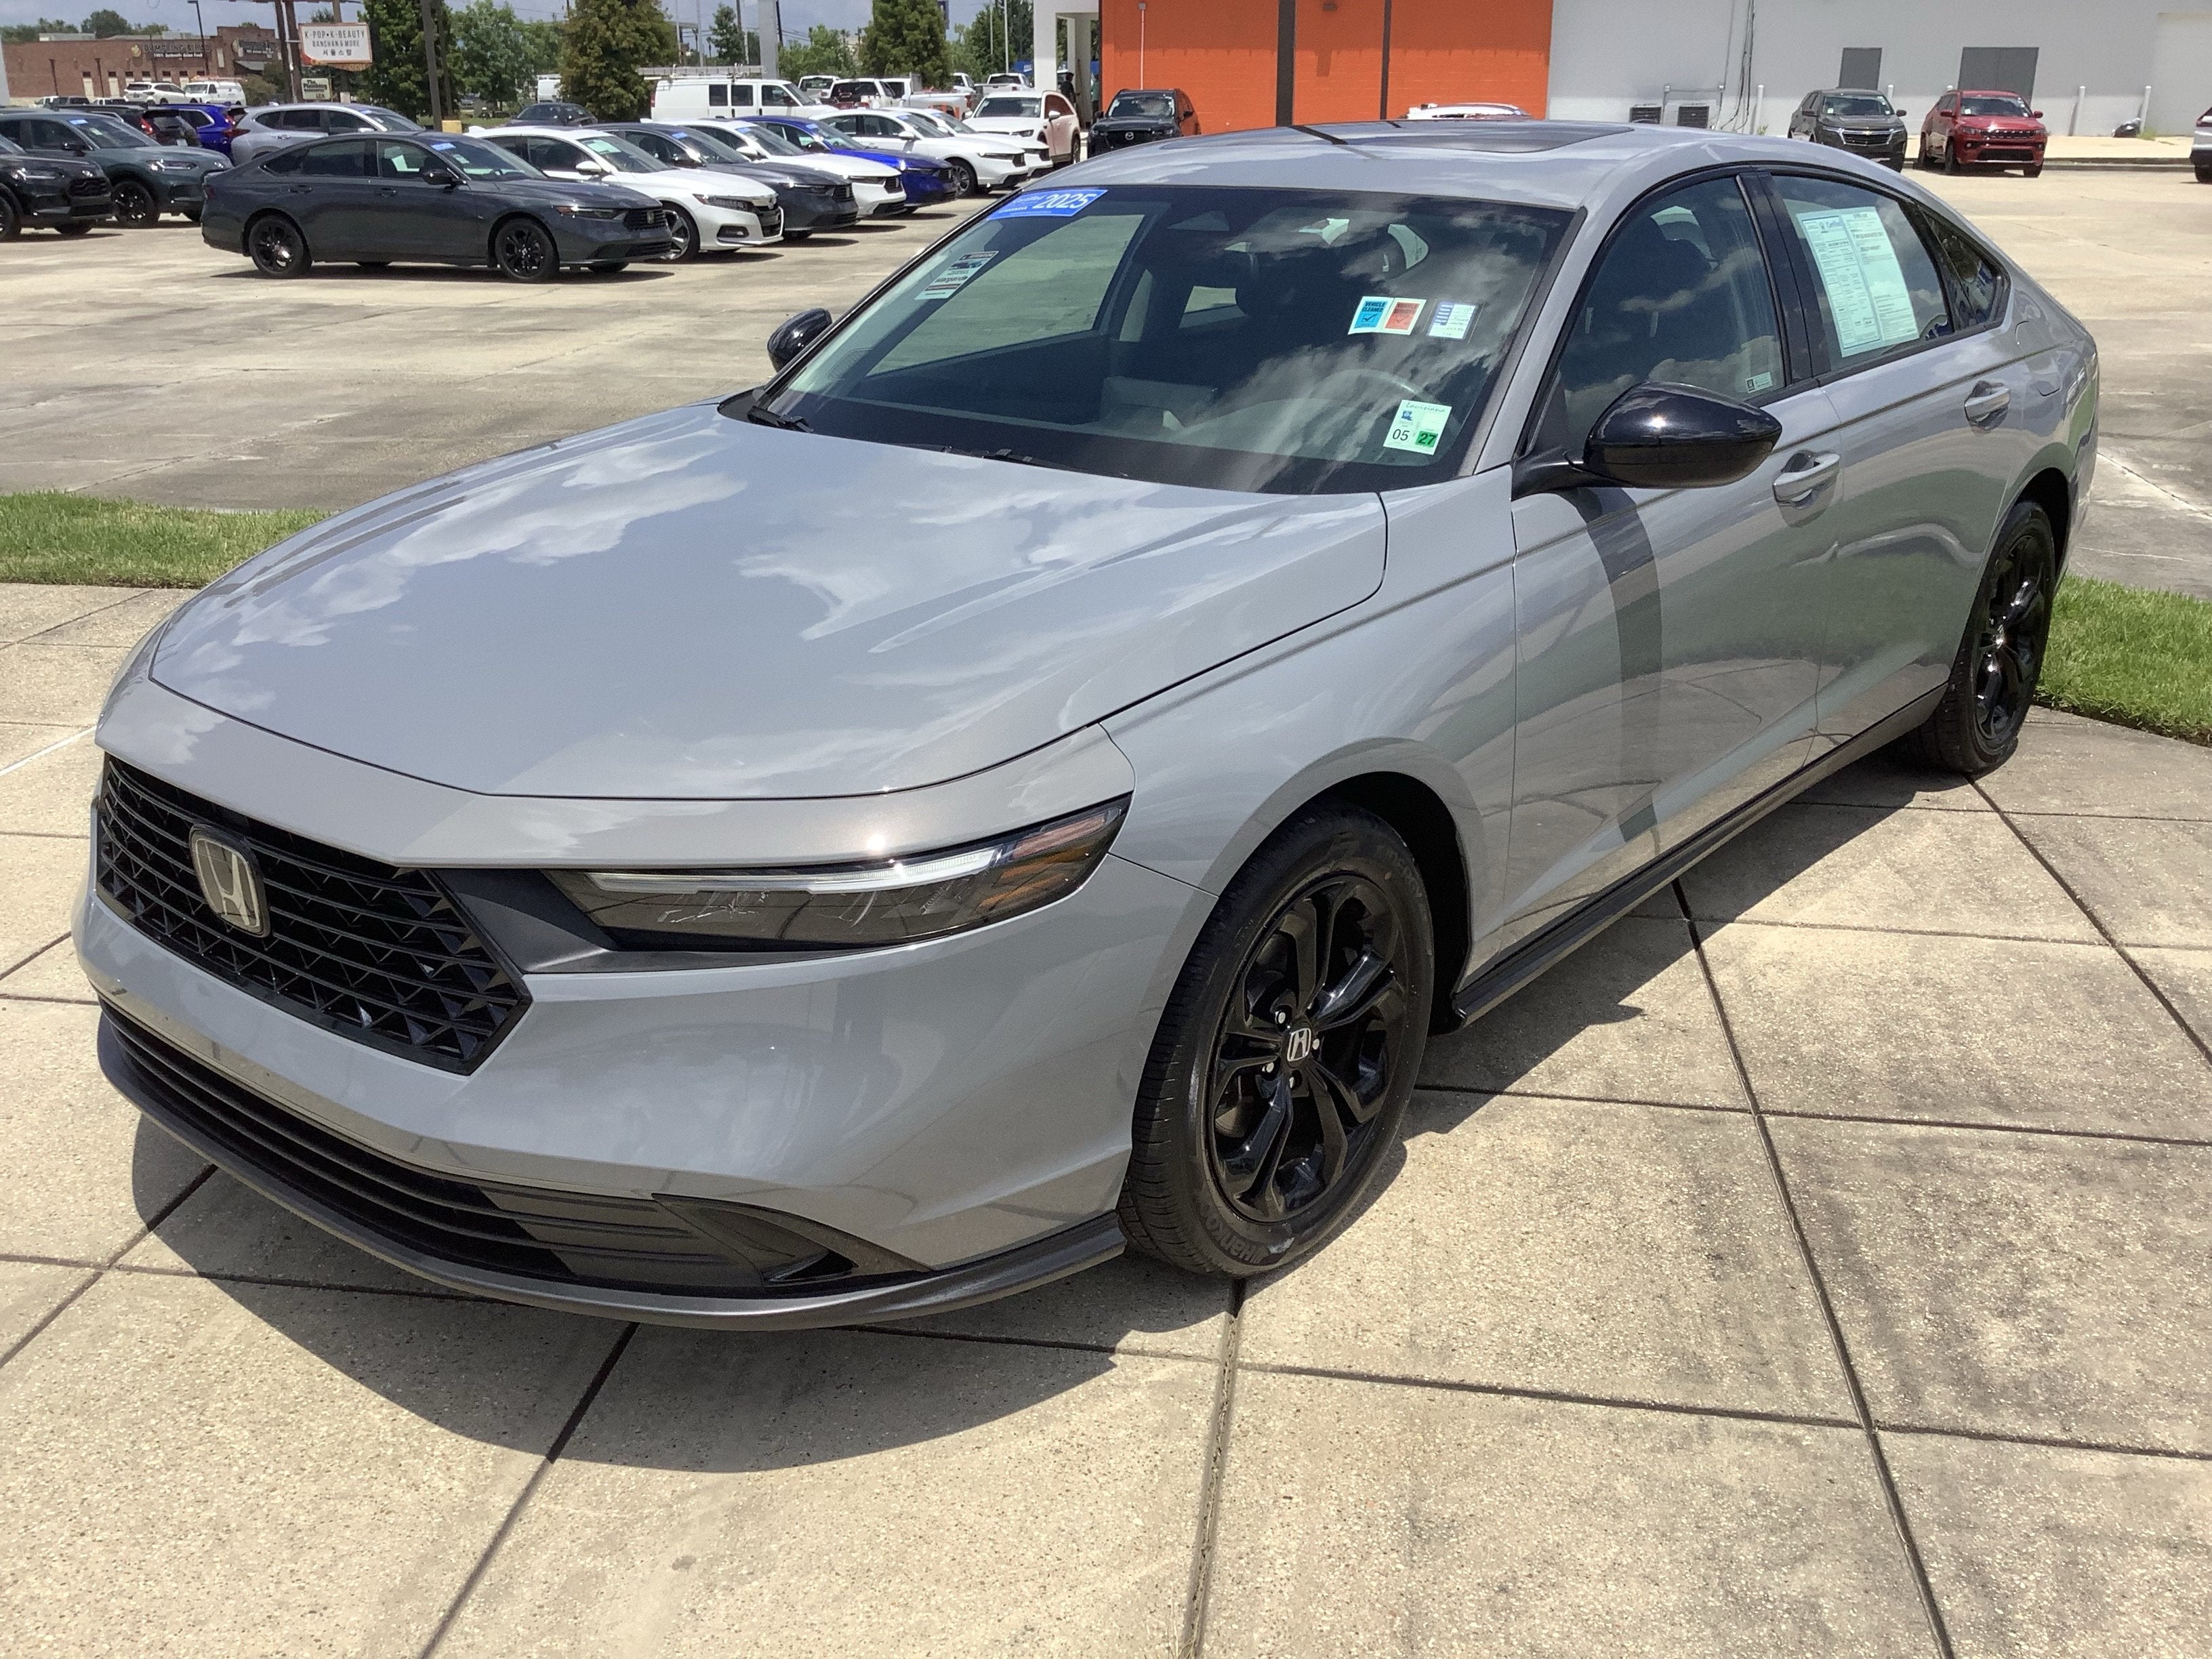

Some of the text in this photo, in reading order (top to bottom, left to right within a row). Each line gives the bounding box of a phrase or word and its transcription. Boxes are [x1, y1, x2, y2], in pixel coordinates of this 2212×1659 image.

[1031, 193, 1097, 209] 2025
[1406, 402, 1446, 413] Louisiana
[1392, 428, 1410, 441] 05
[1418, 432, 1437, 446] 27
